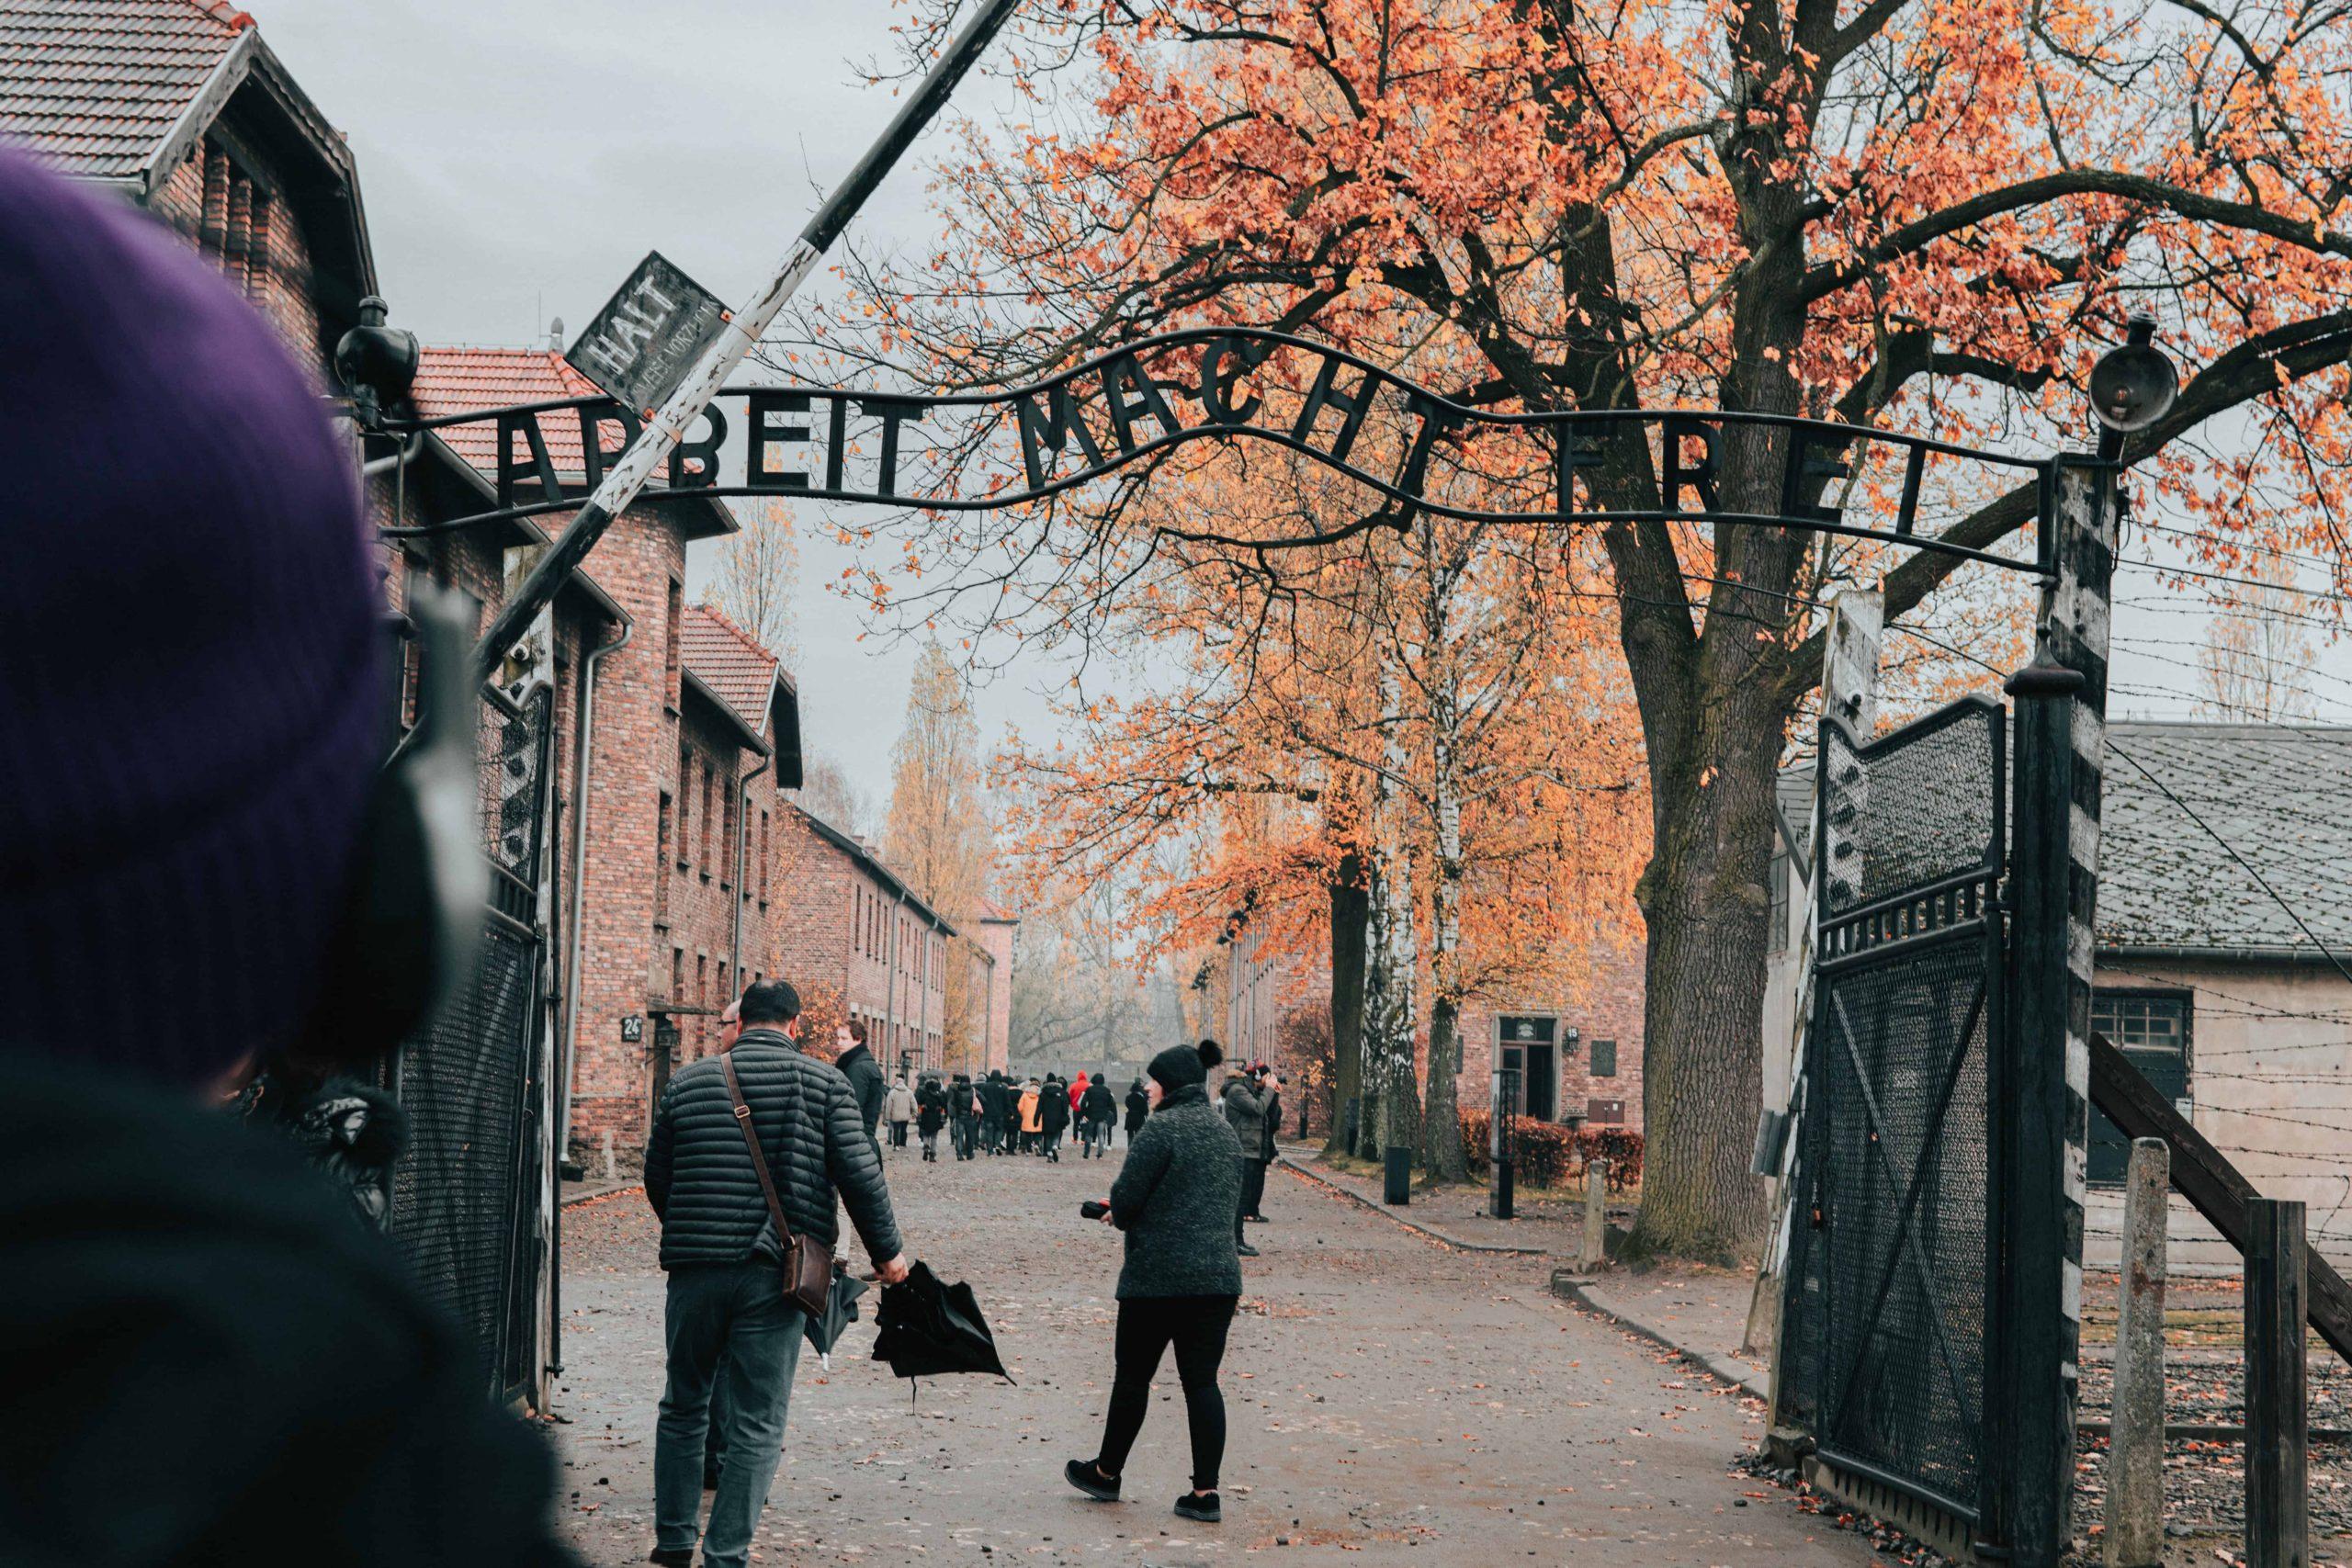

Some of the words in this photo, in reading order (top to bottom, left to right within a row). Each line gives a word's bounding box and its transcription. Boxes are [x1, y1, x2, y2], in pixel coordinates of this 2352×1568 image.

[587, 275, 677, 376] HALT
[622, 355, 673, 413] AWEISE
[496, 394, 925, 509] ARBEIT
[1015, 336, 1464, 498] MACHT
[1557, 420, 1927, 536] FREI
[625, 1018, 642, 1034] 24
